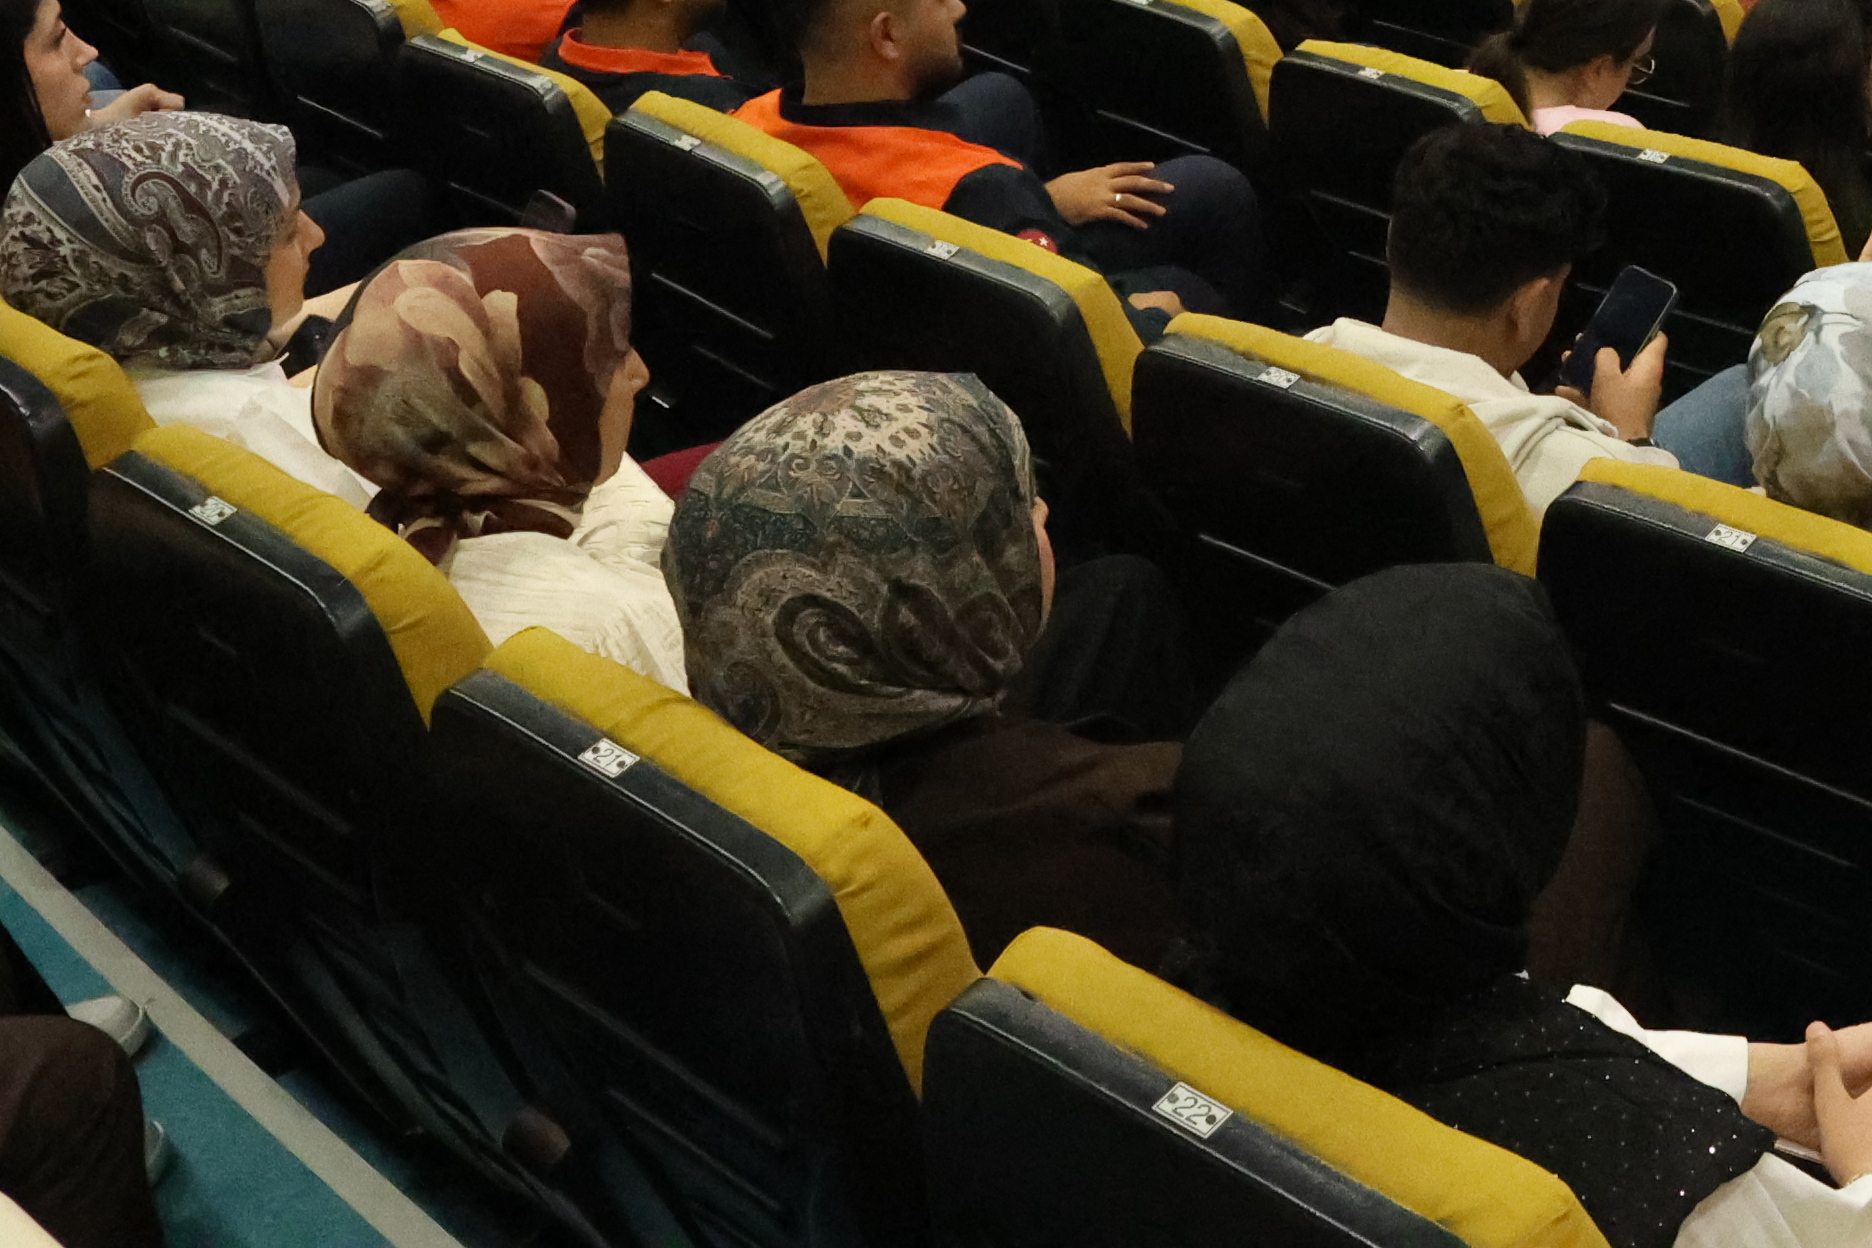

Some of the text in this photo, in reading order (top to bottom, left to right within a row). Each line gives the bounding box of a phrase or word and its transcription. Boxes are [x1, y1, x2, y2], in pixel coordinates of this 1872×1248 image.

[1716, 531, 1742, 546] 21
[593, 748, 623, 768] 21
[1172, 1096, 1212, 1126] 22
